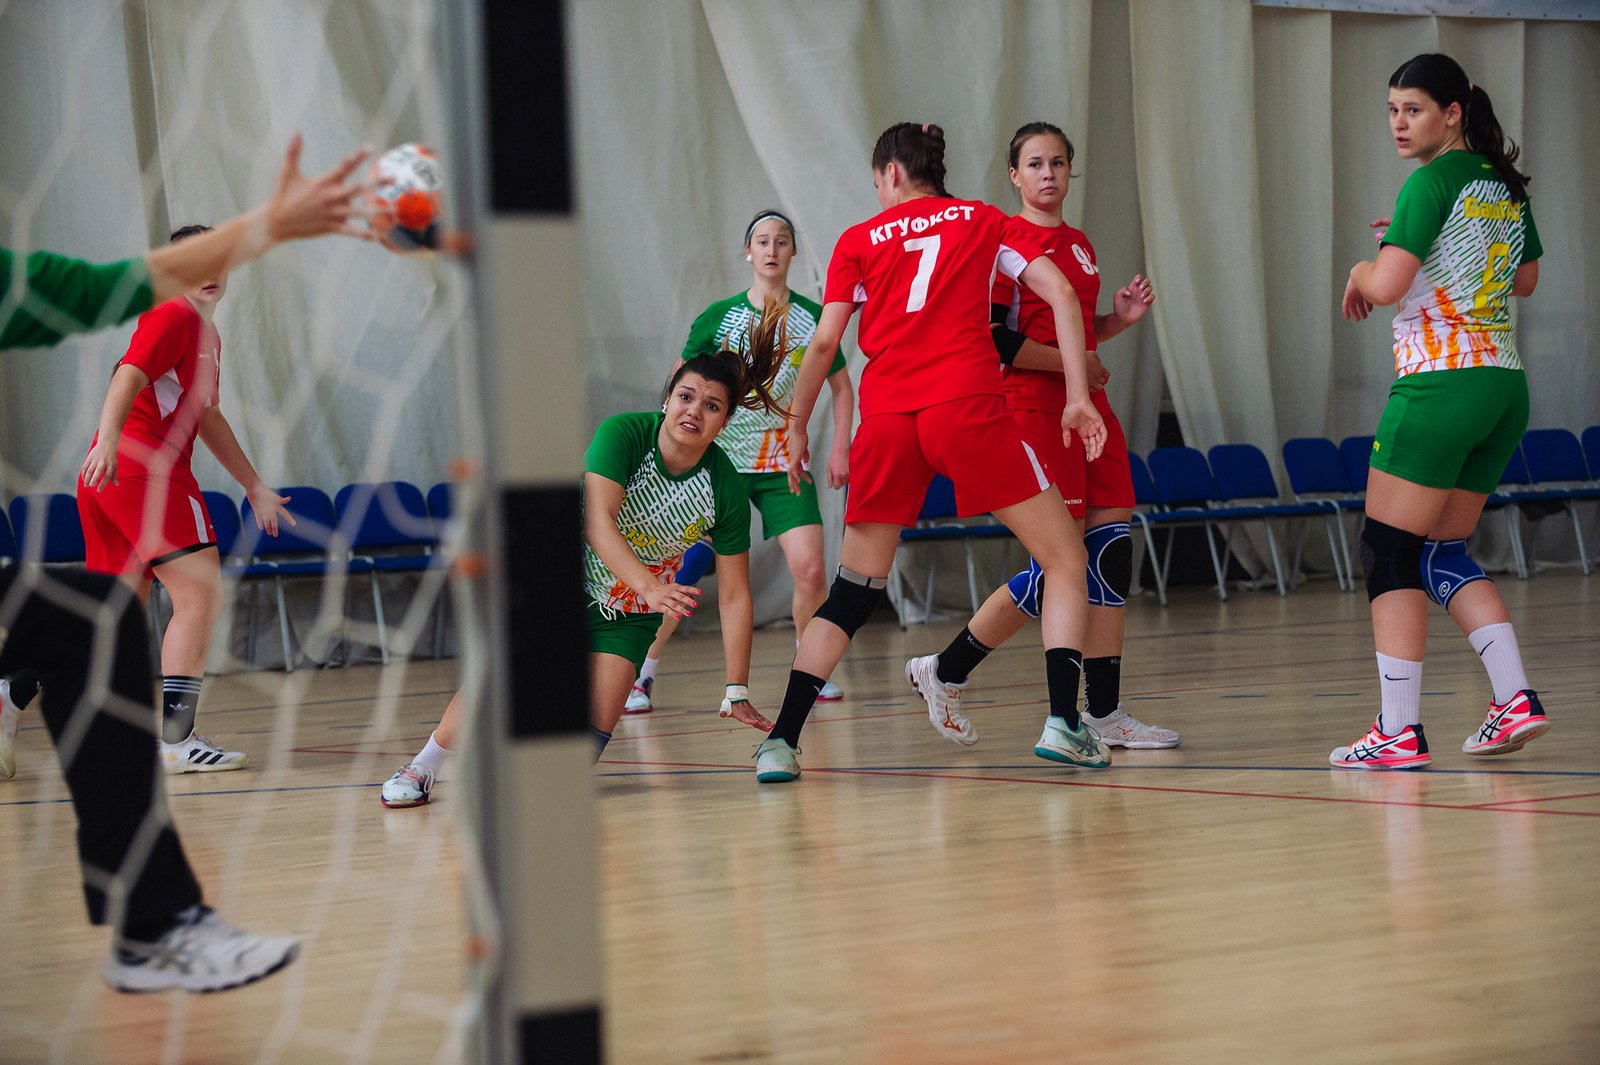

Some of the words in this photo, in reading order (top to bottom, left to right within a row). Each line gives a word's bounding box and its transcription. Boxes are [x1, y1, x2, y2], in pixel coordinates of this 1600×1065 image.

[869, 205, 975, 246] КГУФКСТ
[903, 234, 941, 313] 7
[1071, 243, 1099, 275] 9
